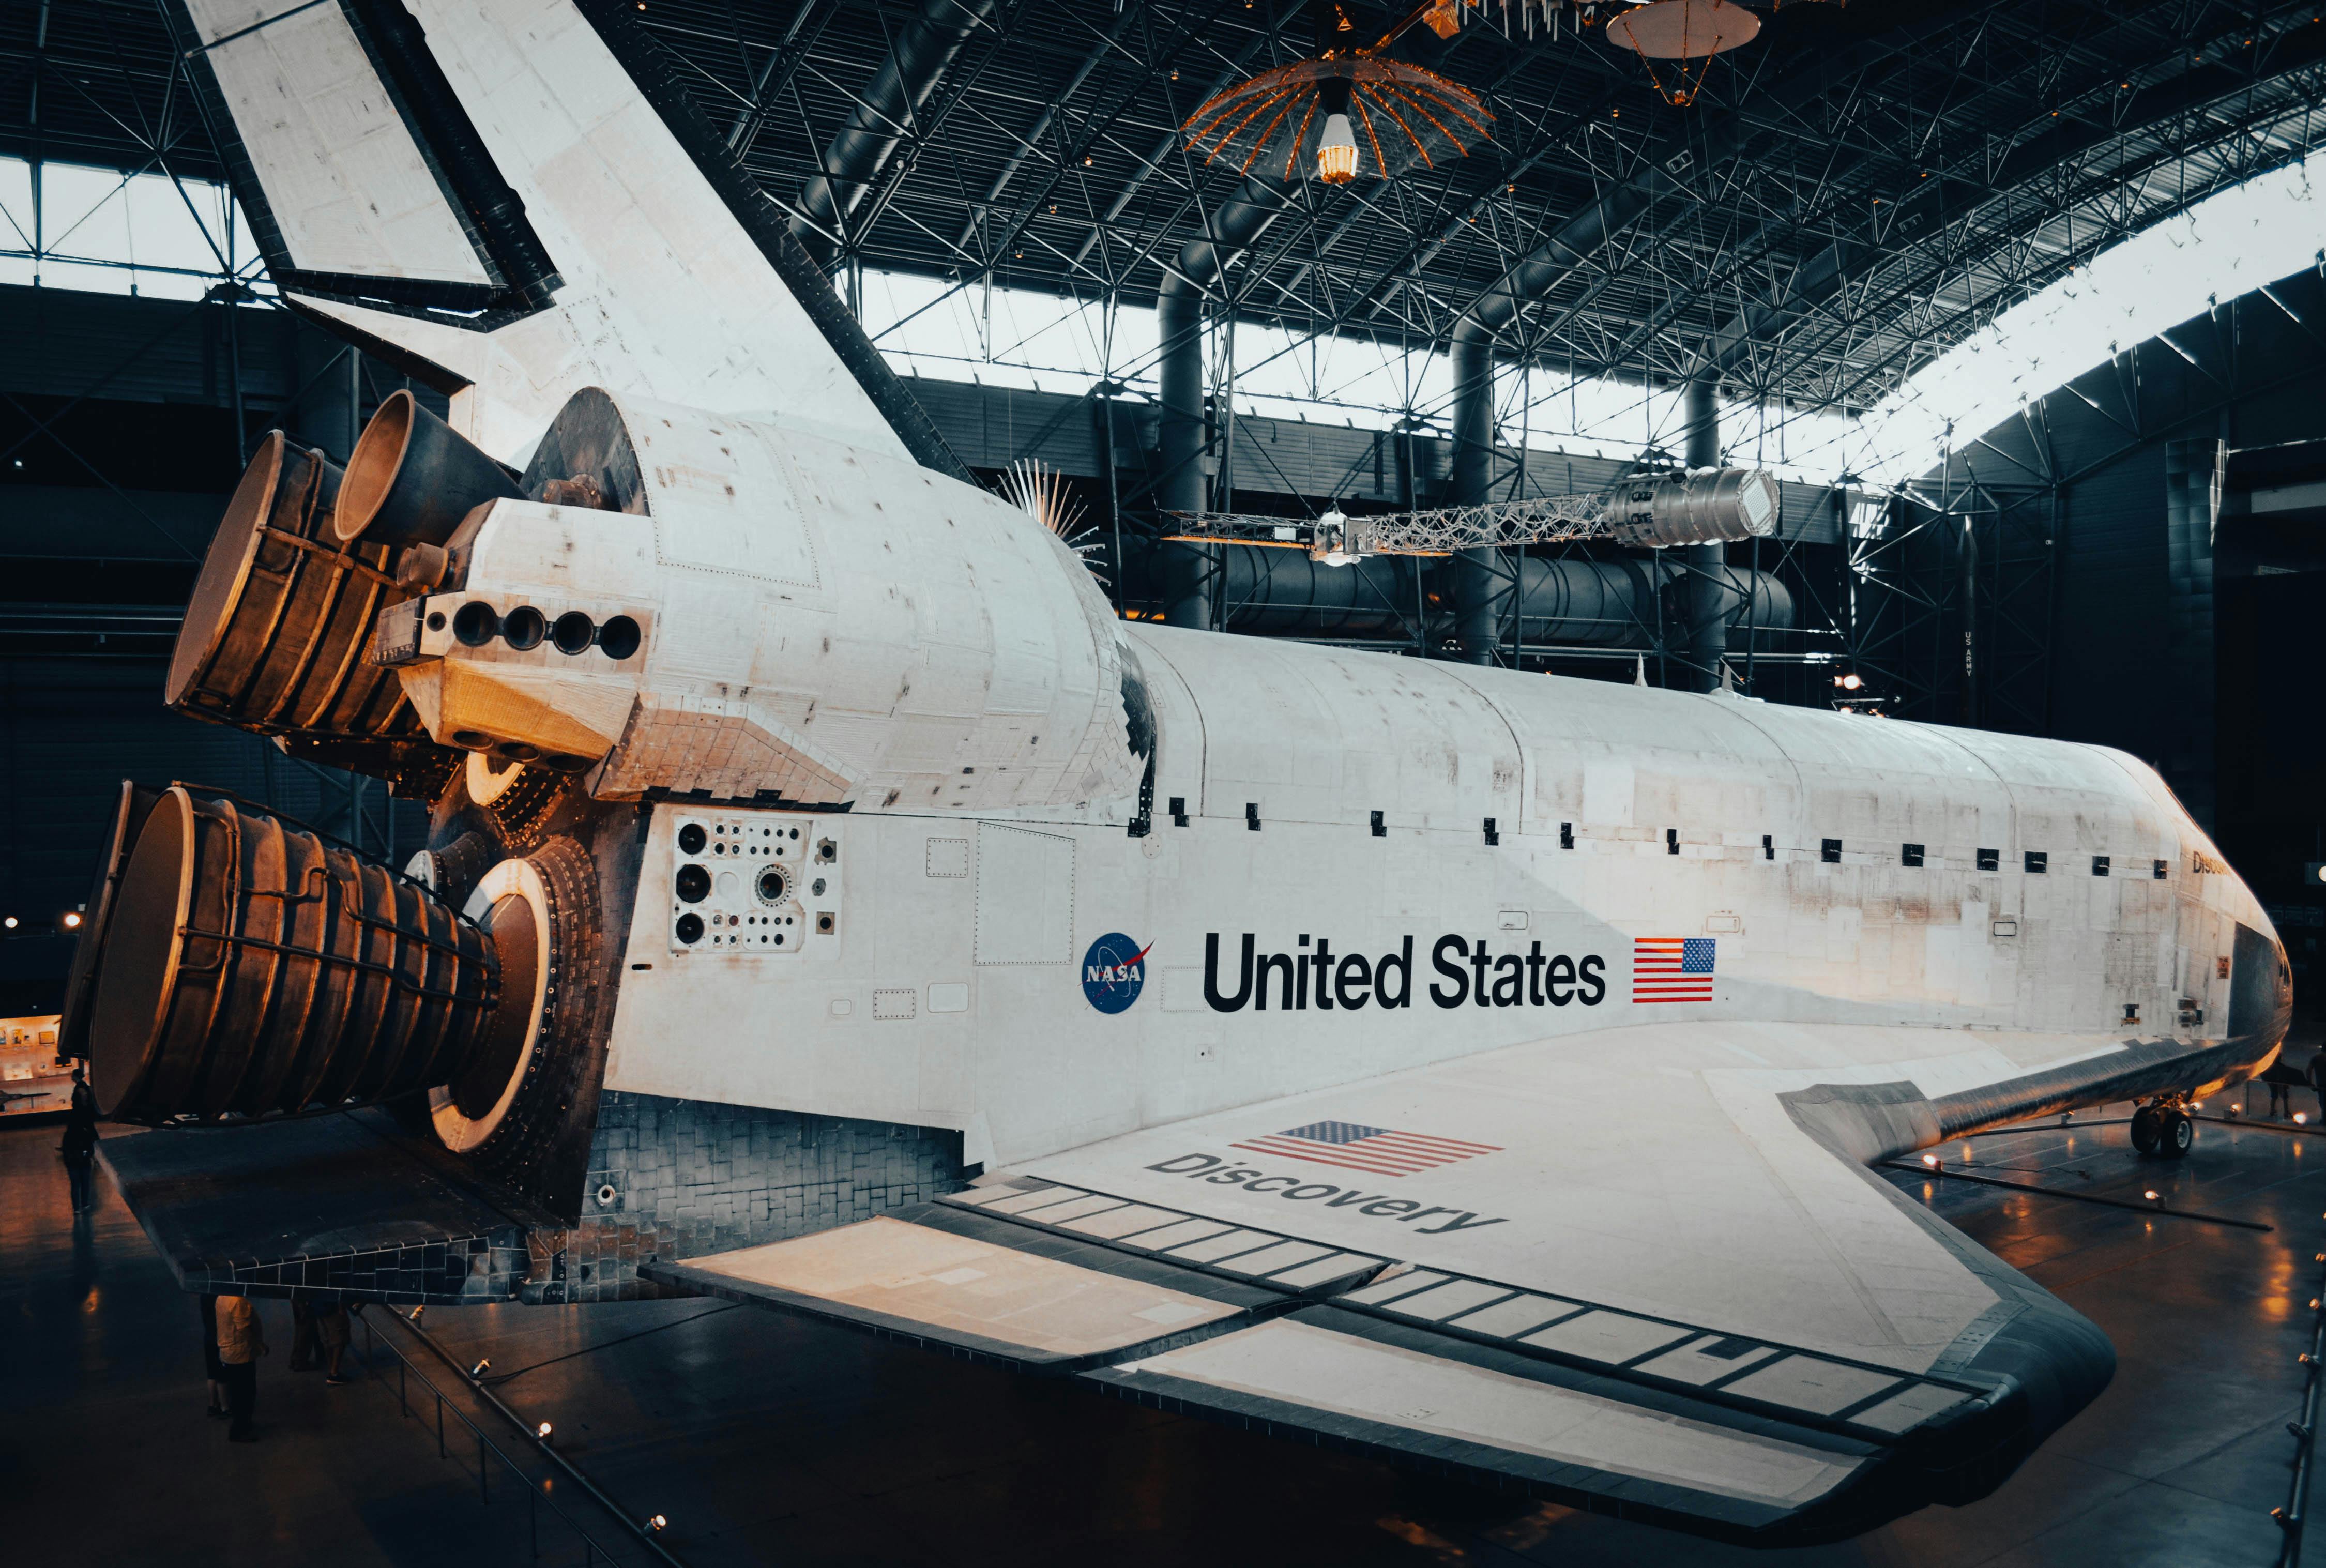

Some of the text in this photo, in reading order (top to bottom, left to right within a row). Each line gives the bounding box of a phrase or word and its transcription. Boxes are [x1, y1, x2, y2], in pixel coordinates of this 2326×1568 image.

[1965, 631, 1971, 645] US
[1087, 965, 1141, 982] NASA
[1204, 933, 1606, 1013] United States
[1144, 1153, 1510, 1235] Discovery
